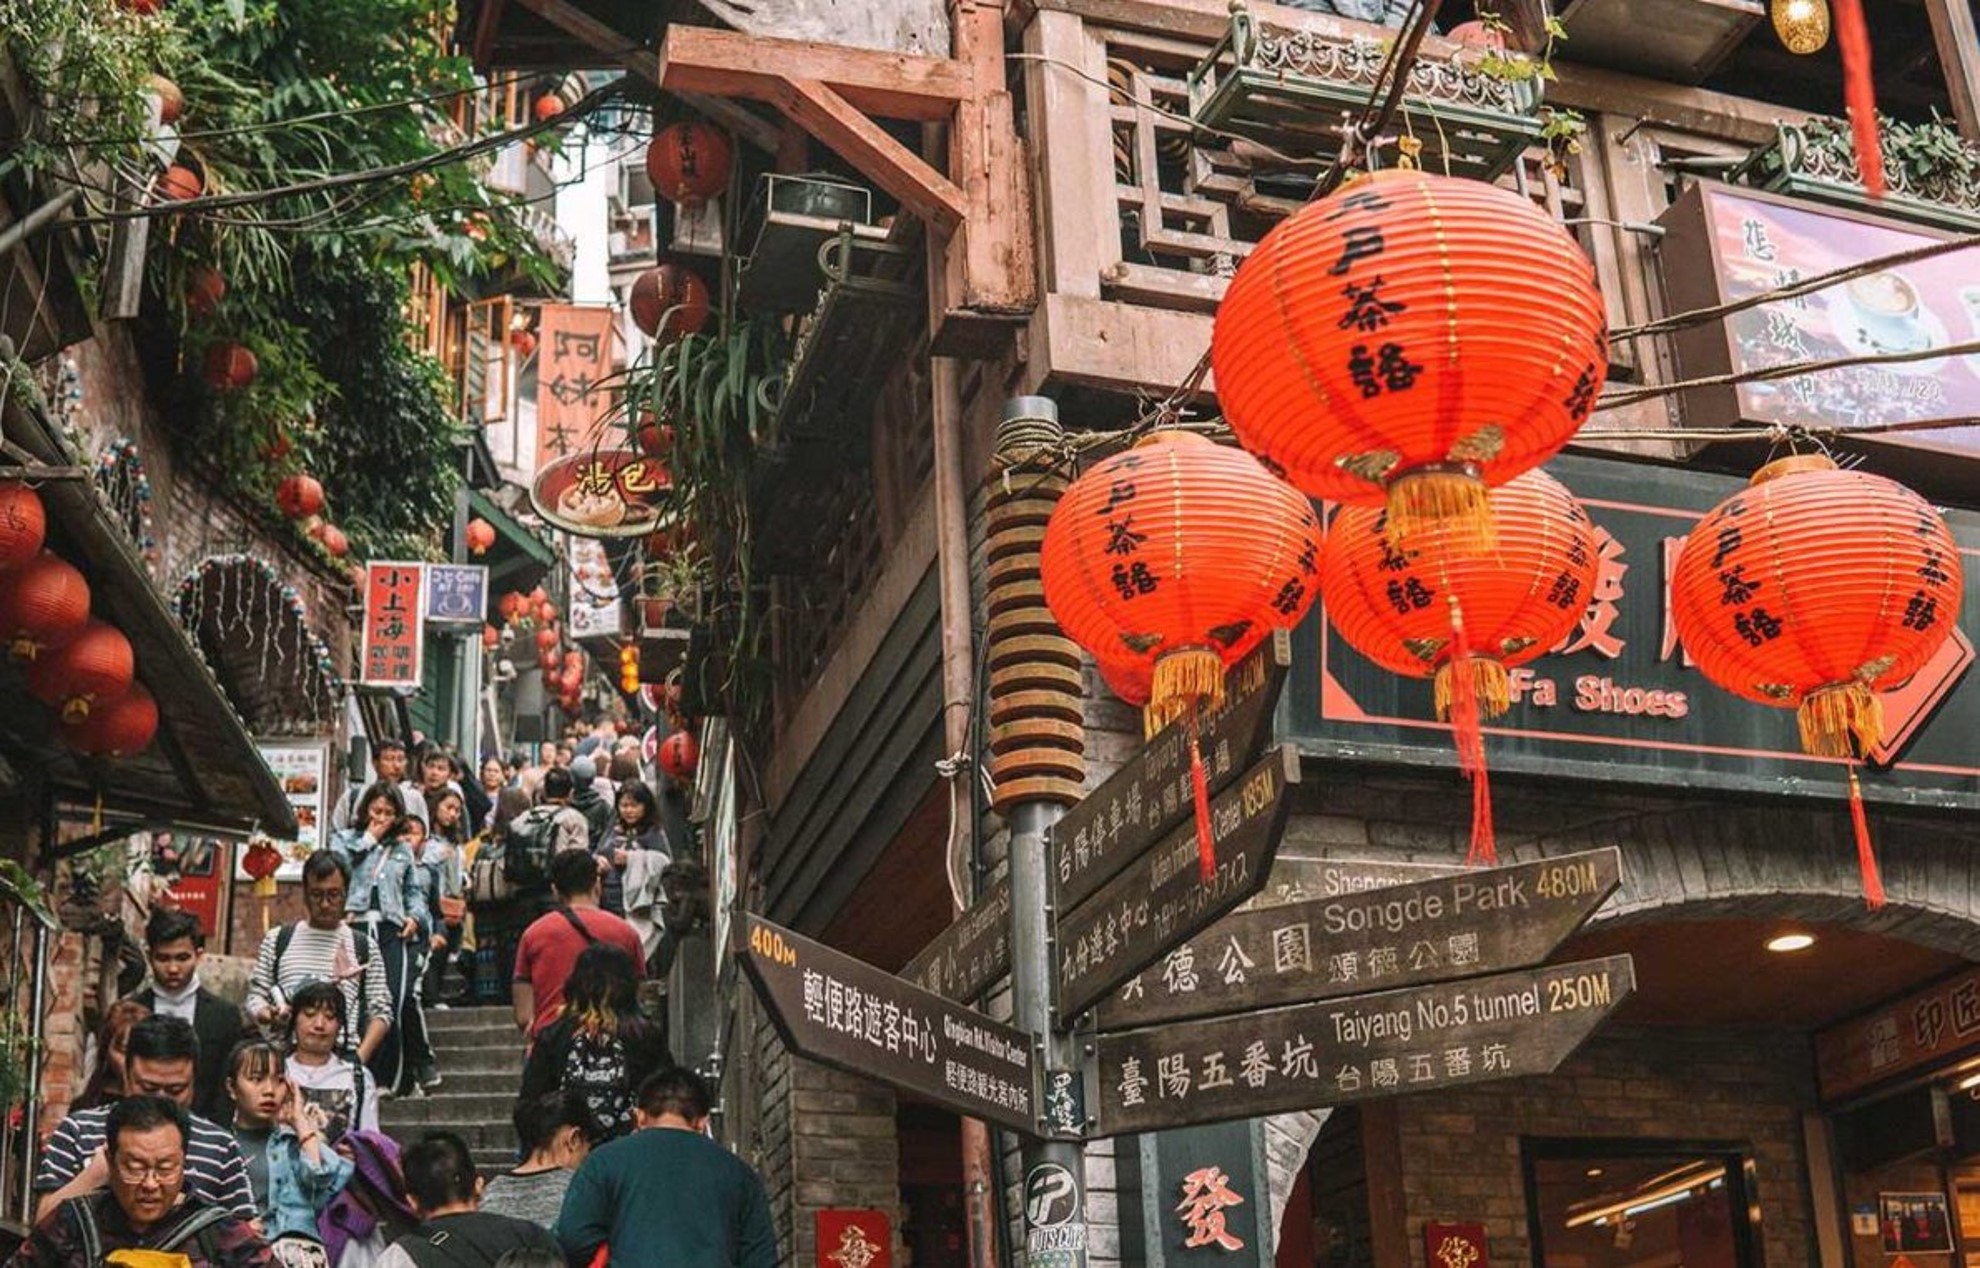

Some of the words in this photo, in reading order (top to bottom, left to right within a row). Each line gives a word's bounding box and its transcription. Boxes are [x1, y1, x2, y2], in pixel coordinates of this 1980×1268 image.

[377, 570, 411, 641] 小上海
[1509, 668, 1556, 706] Fa
[1575, 674, 1689, 719] Shoes
[1242, 766, 1275, 820] 185M
[1324, 893, 1443, 934] Songde
[1452, 875, 1530, 916] Park
[1535, 862, 1598, 899] 480M
[802, 966, 938, 1065] 輕便路遊客中心
[1330, 1010, 1411, 1049] Taiyang
[1417, 994, 1470, 1032] No.5
[1474, 983, 1541, 1020] tunnel
[1548, 971, 1612, 1014] 250M
[1116, 1033, 1320, 1108] 臺陽五番坑
[1335, 1042, 1511, 1093] 台陽五番坑
[1174, 1164, 1245, 1252] 發
